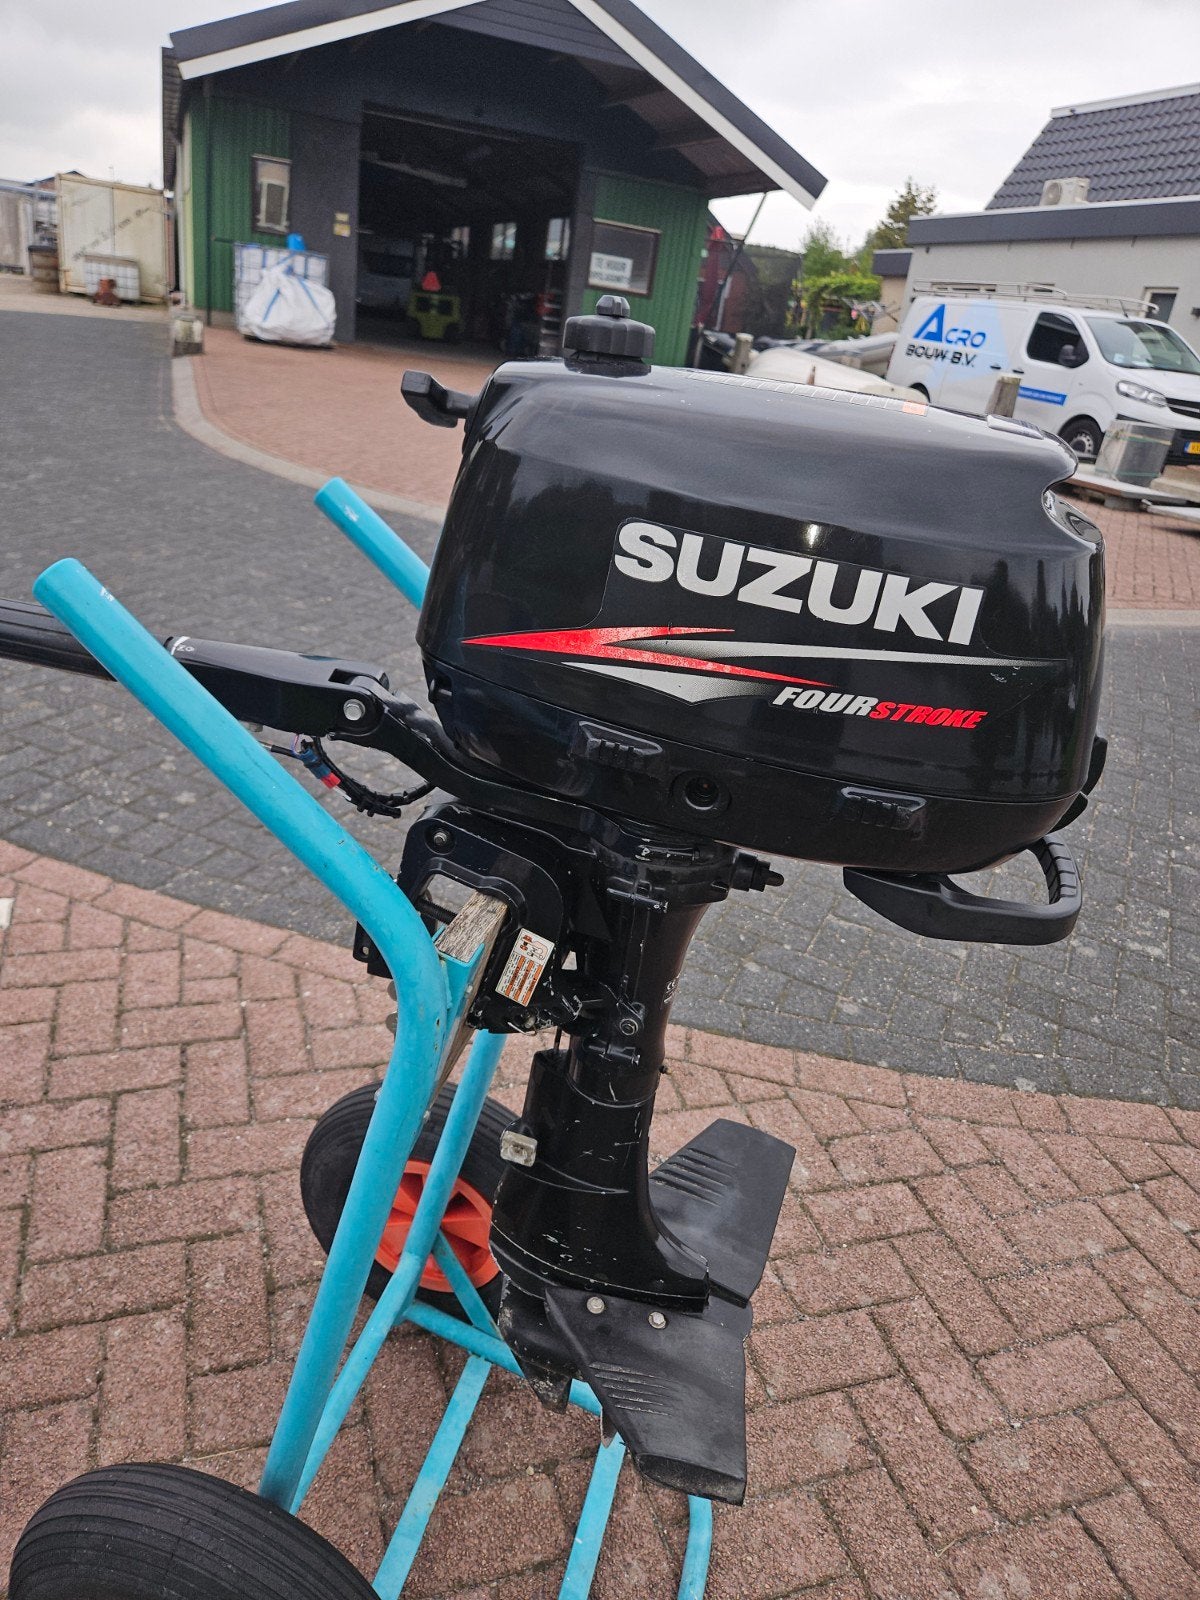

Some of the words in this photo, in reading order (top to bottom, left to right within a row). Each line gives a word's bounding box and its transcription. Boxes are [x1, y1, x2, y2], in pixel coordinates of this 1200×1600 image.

[905, 344, 948, 362] BOUW
[950, 351, 977, 368] B.V.
[614, 522, 984, 646] SUZUKI
